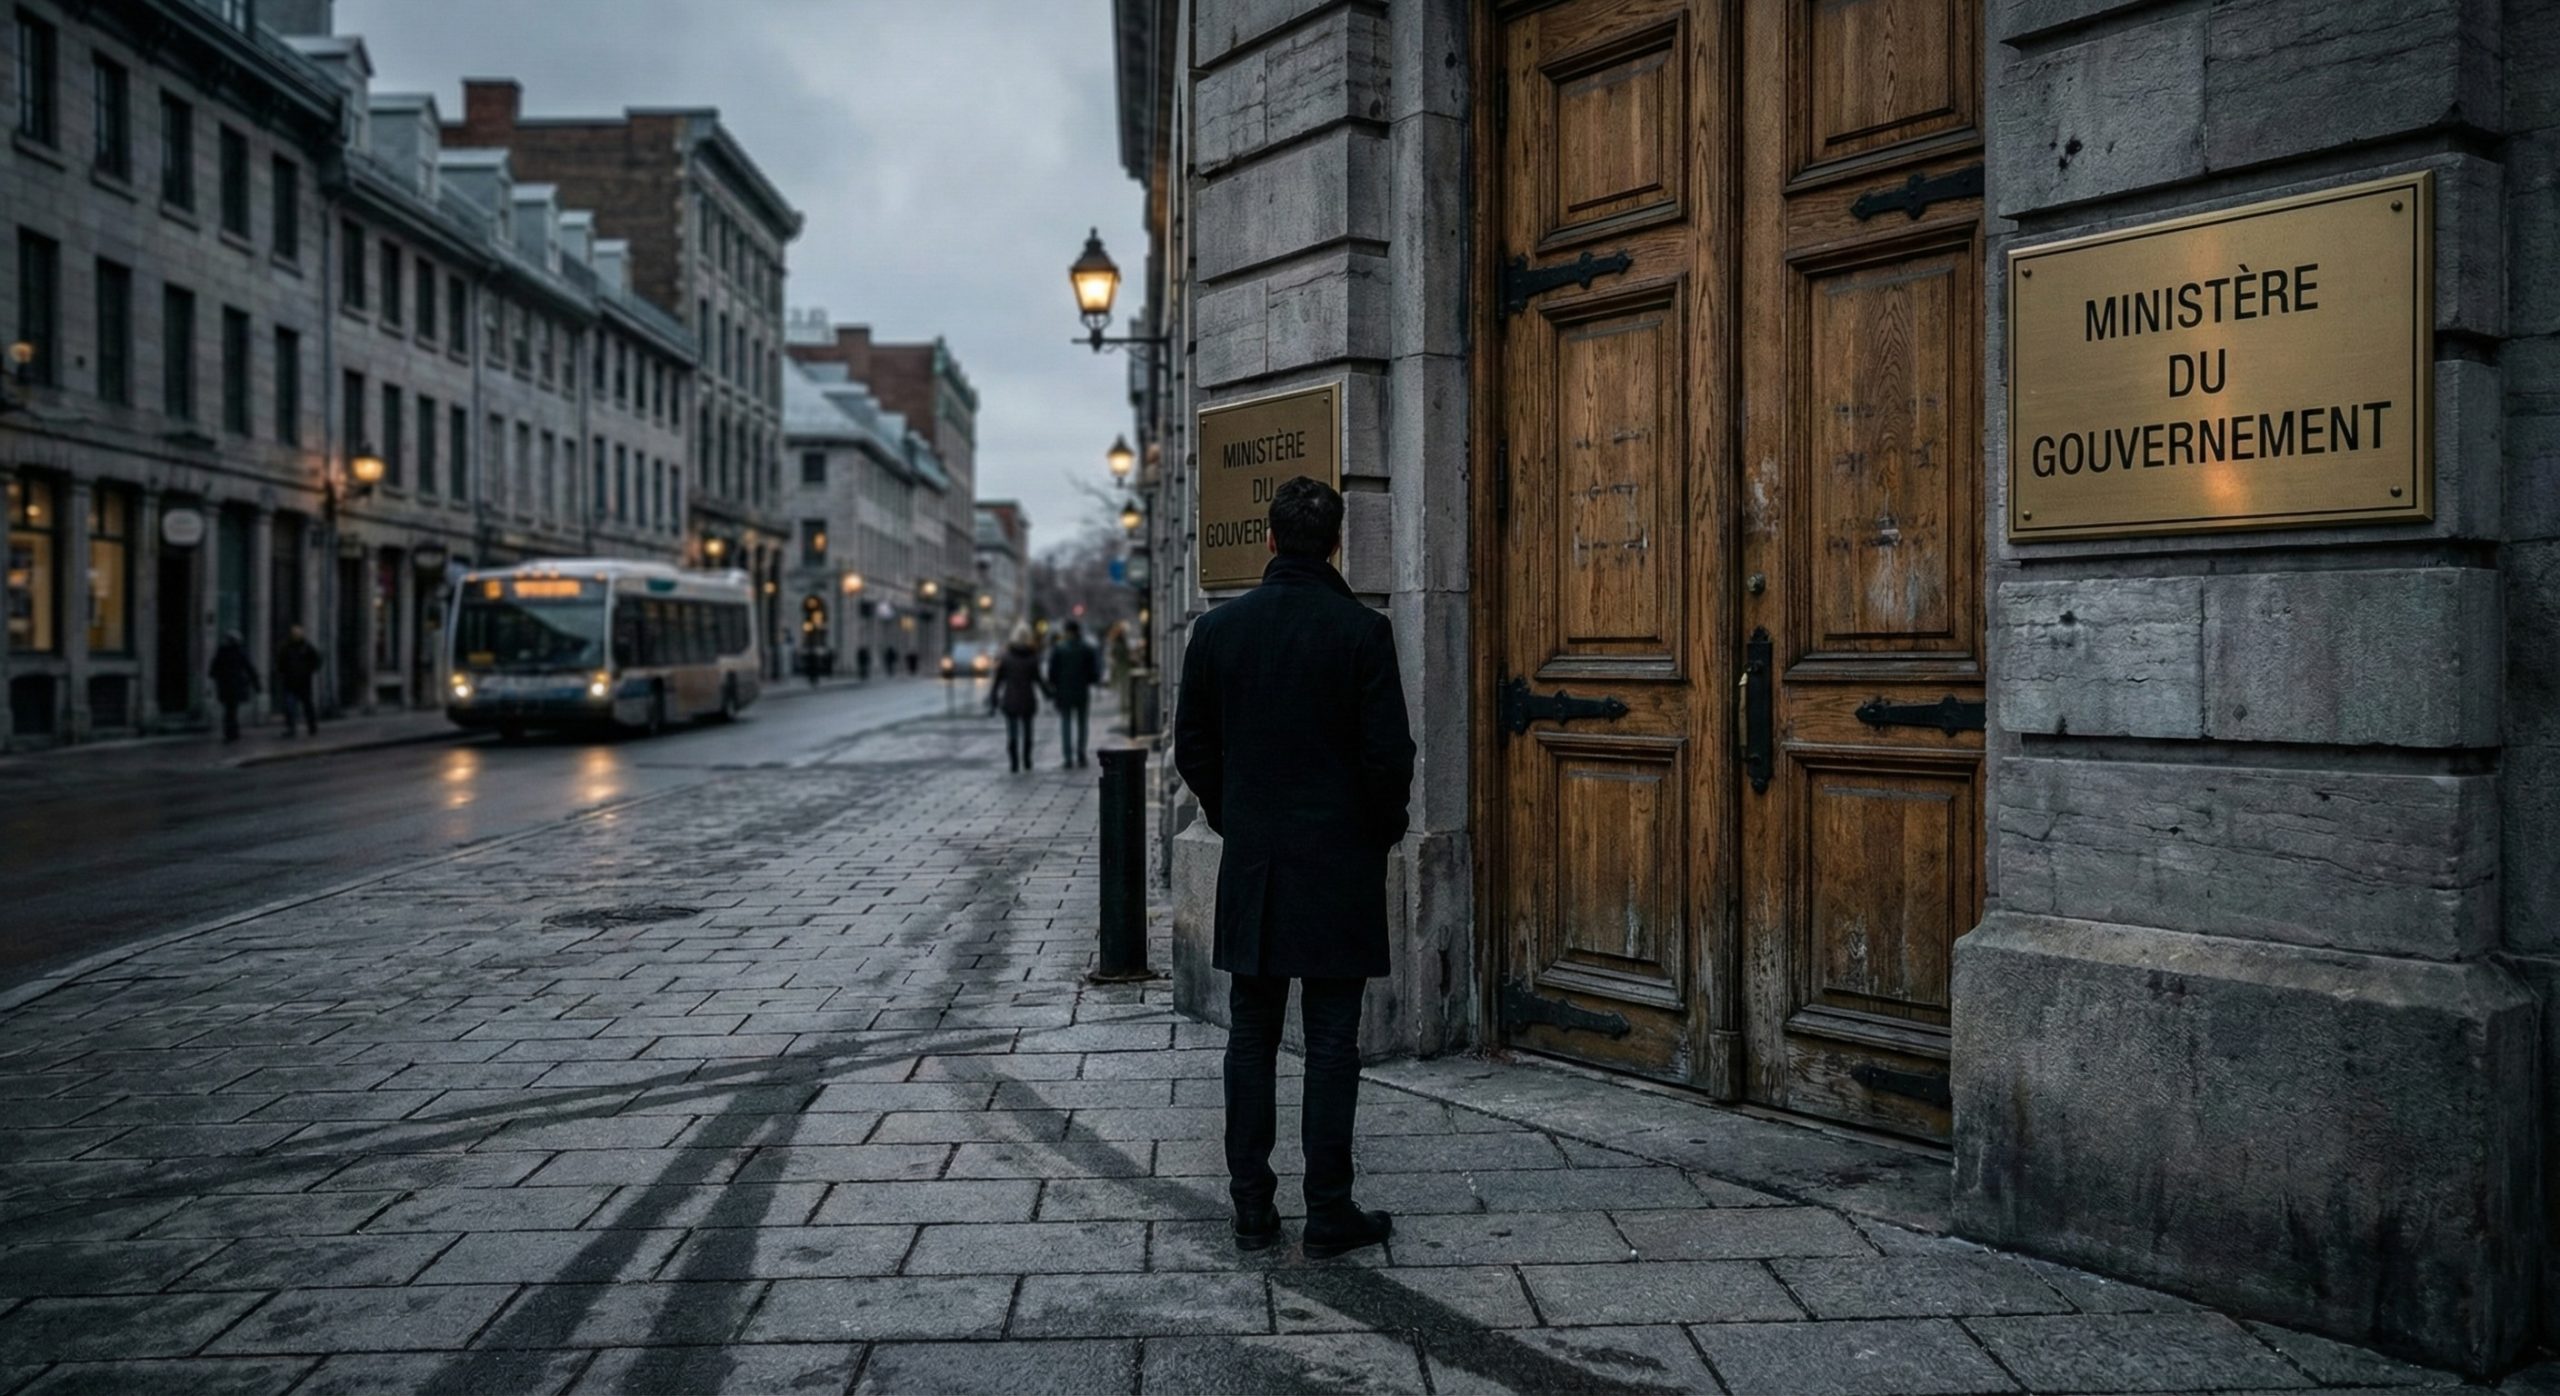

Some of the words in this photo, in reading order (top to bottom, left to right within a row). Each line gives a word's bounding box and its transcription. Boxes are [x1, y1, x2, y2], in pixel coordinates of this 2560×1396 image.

[2084, 263, 2319, 342] MINISTÈRE
[2168, 348, 2226, 398] DU
[1223, 428, 1305, 469] MINISTÈRE
[2032, 400, 2392, 478] GOUVERNEMENT
[1253, 477, 1274, 504] DU
